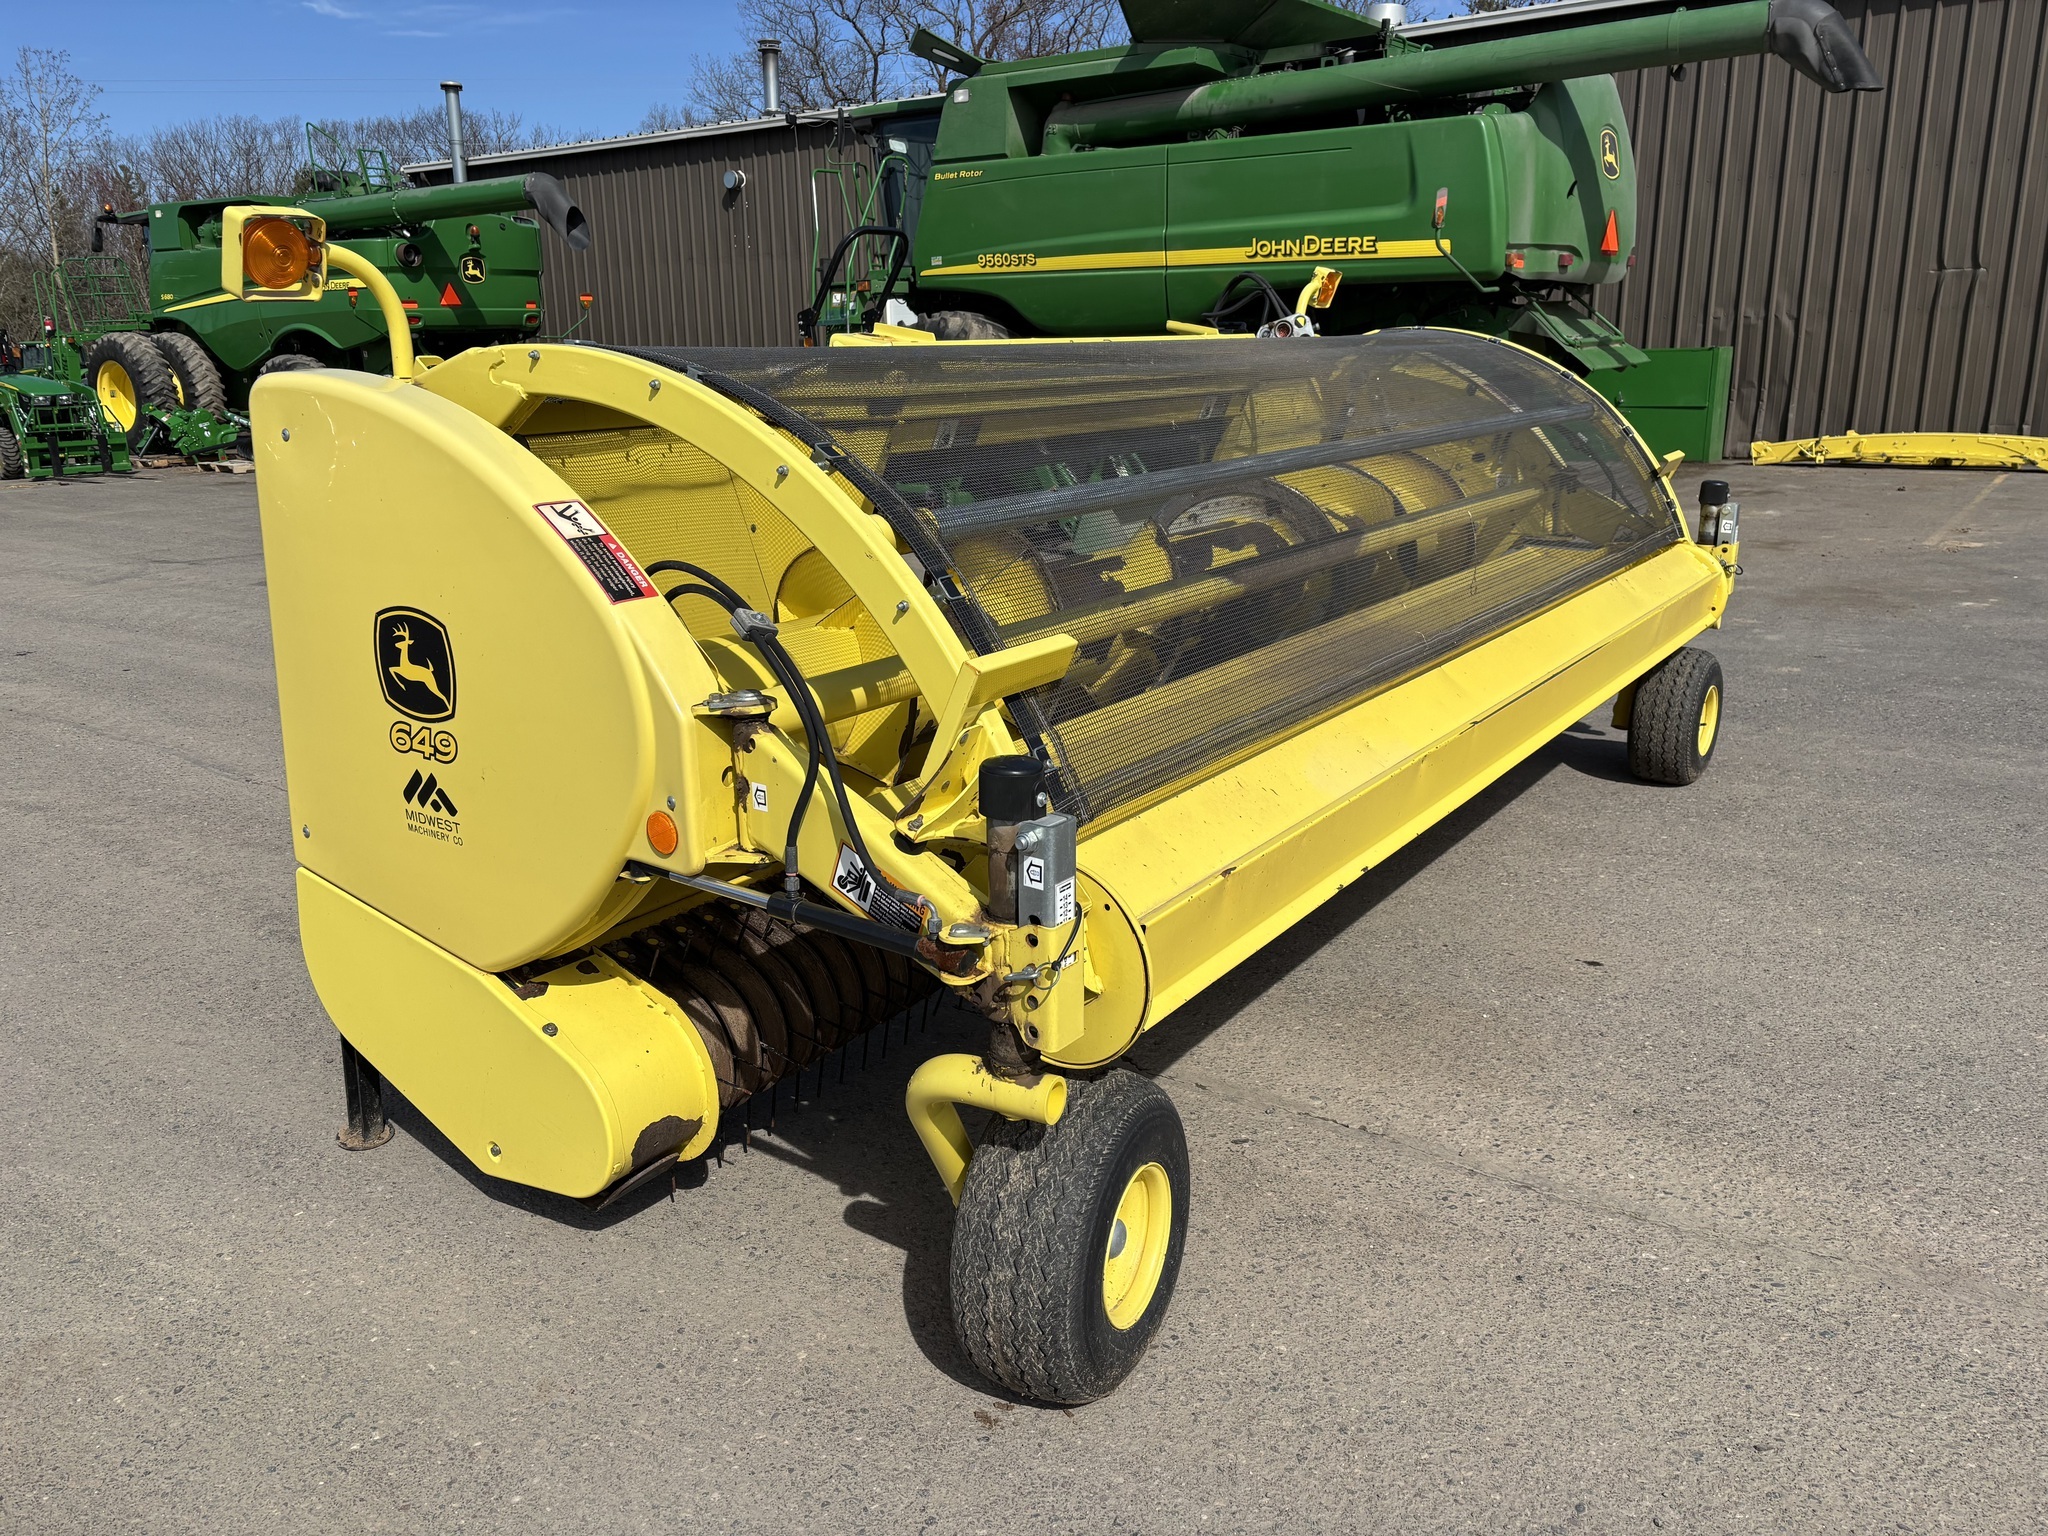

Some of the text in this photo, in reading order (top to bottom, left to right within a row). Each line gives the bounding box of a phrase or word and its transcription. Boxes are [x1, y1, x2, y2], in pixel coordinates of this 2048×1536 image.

[934, 169, 983, 181] Bullet Rotor
[1245, 235, 1377, 257] JOHN DEERE
[977, 253, 1036, 267] 9560STS
[616, 551, 648, 588] DANGER
[389, 720, 458, 764] 649
[405, 808, 461, 834] MIDWEST
[407, 823, 464, 847] MACHINERY CO
